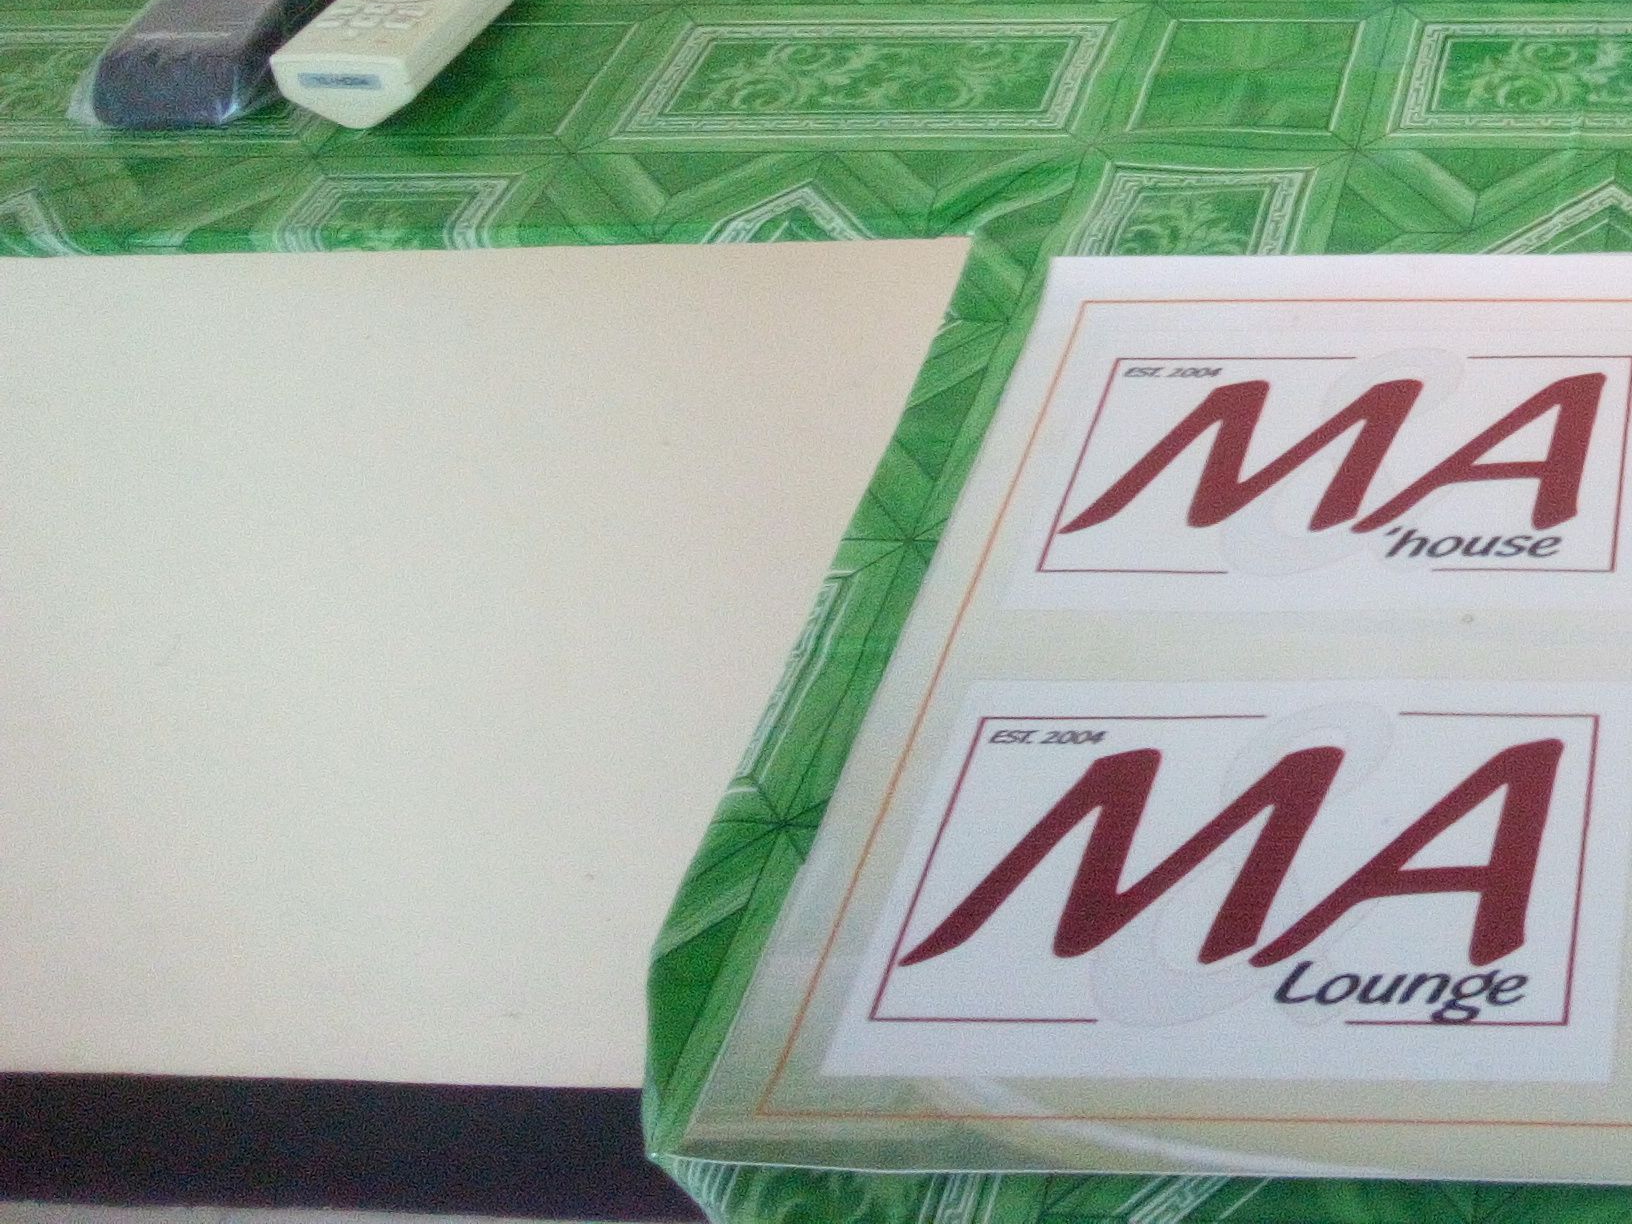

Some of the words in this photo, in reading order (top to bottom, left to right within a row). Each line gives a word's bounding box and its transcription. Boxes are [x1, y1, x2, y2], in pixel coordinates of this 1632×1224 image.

[1057, 372, 1608, 534] MA
[1040, 729, 1107, 745] 2004
[898, 738, 1565, 968] MA
[1272, 959, 1529, 1025] Lounge
